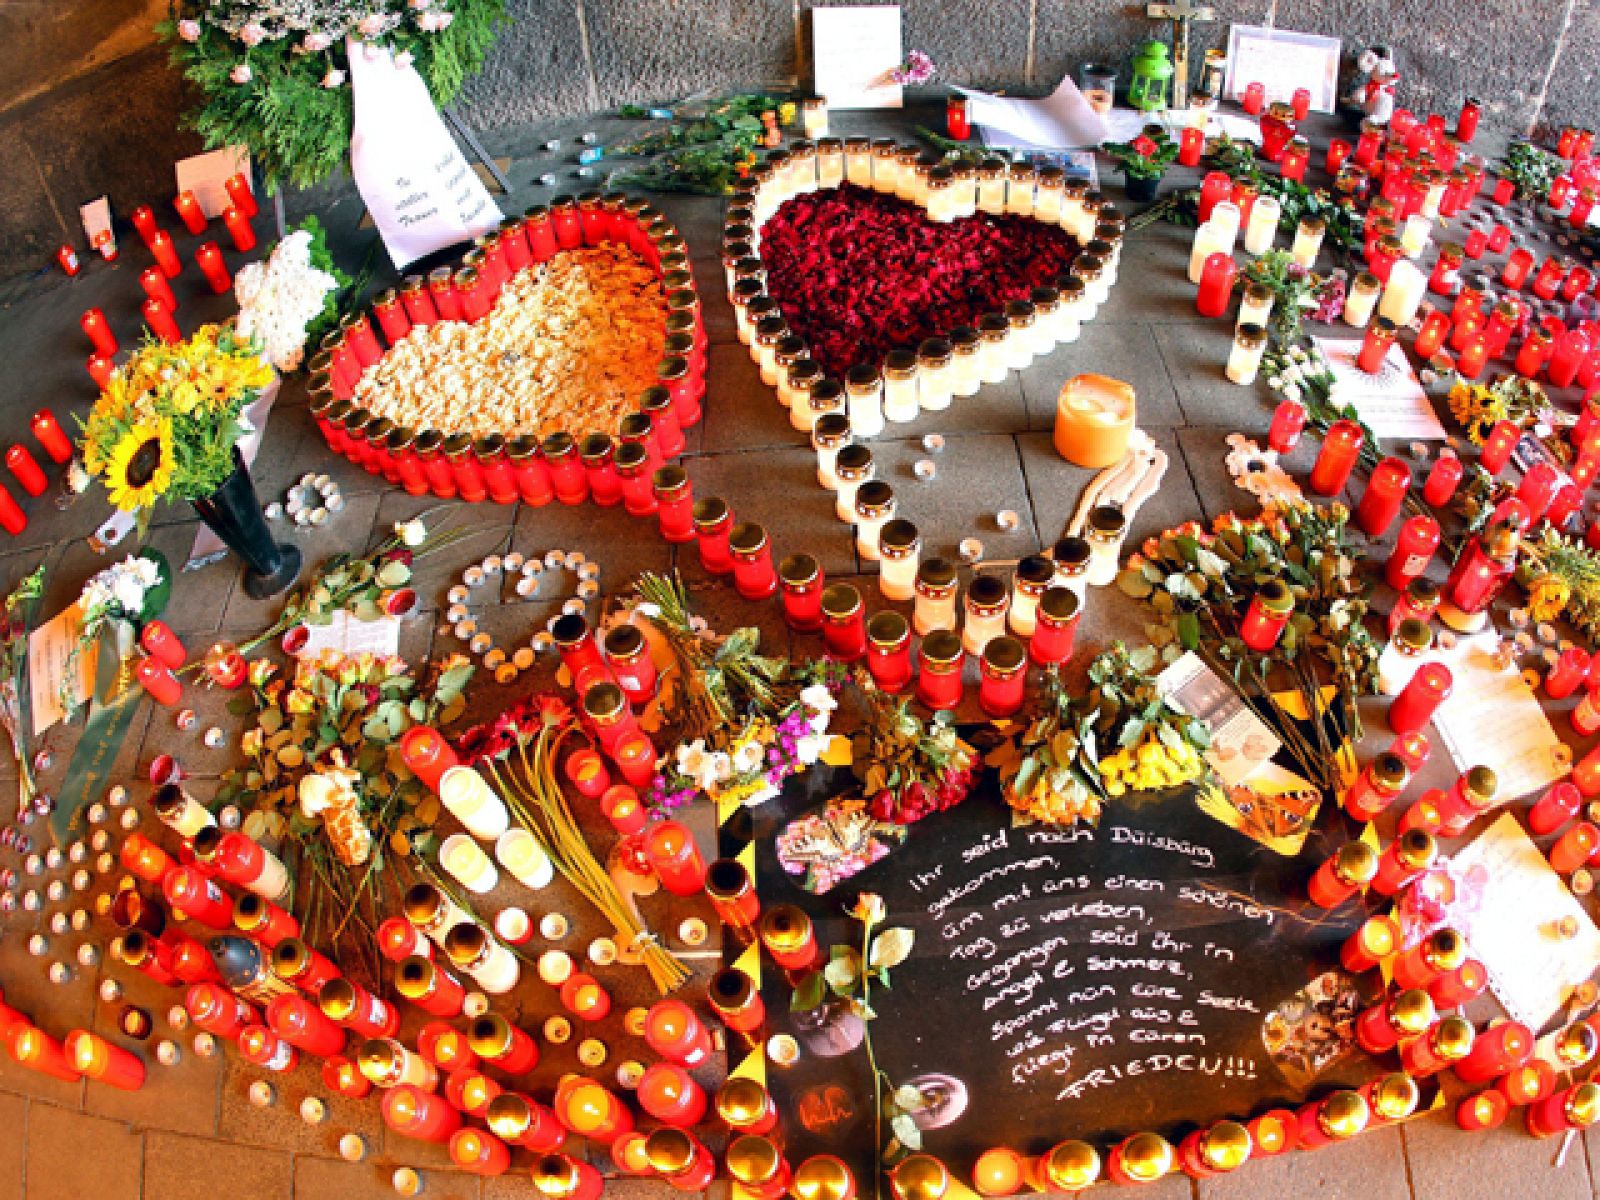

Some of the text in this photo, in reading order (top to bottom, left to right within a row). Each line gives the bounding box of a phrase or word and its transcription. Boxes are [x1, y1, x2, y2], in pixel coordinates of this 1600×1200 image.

[961, 828, 1009, 863] seid
[1027, 827, 1095, 845] nach
[1104, 874, 1166, 892] einen
[1089, 925, 1139, 946] seid
